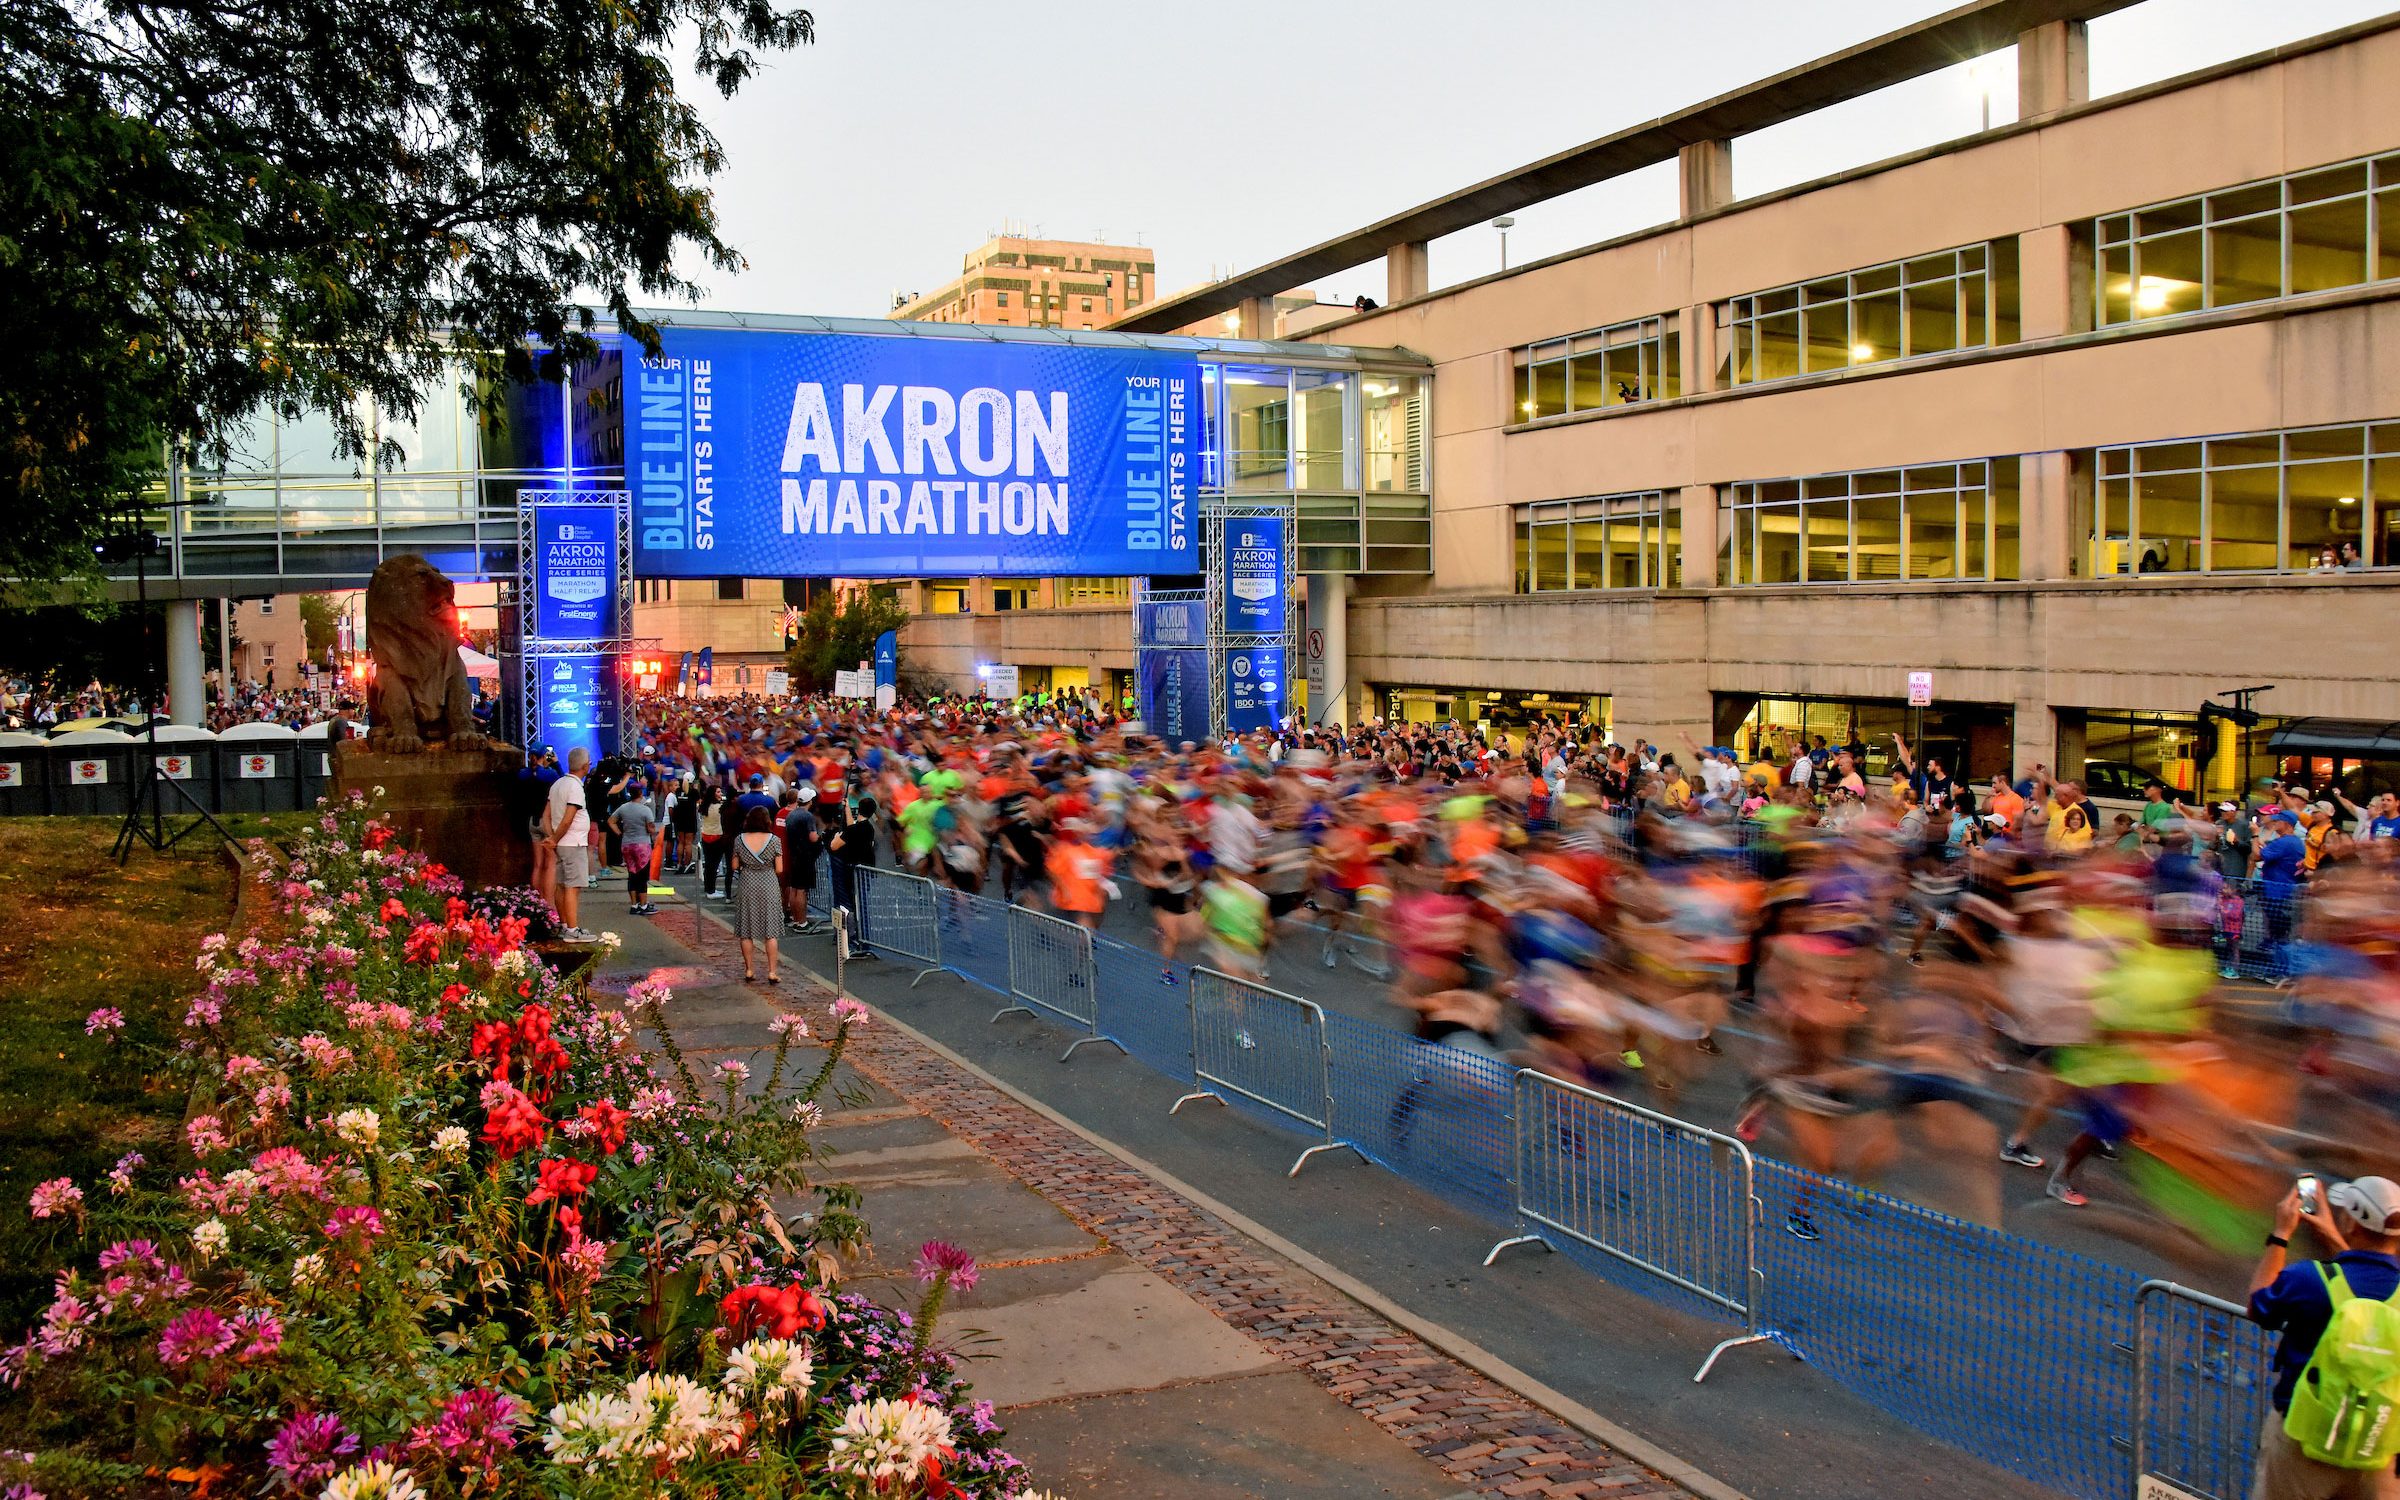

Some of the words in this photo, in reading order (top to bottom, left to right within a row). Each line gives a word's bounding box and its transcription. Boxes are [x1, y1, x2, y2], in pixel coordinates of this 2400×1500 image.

[638, 357, 682, 371] YOUR
[1126, 376, 1160, 388] YOUR
[640, 372, 684, 452] LINE
[693, 359, 712, 432] HERE
[1170, 378, 1185, 444] HERE
[780, 382, 1069, 479] AKRON
[1126, 389, 1161, 462] LINE
[641, 460, 685, 550] BLUE
[695, 440, 714, 550] STARTS
[781, 478, 1069, 536] MARATHON
[1126, 470, 1162, 550] BLUE
[1170, 452, 1187, 551] STARTS
[548, 545, 605, 557] AKRON
[548, 557, 605, 566] MARATHON
[1233, 551, 1276, 561] AKRON
[1155, 606, 1188, 628] AKRON
[1155, 628, 1188, 642] MARATHON
[1167, 698, 1177, 736] BLUE
[1236, 699, 1255, 707] BDO
[1389, 688, 1400, 720] Park
